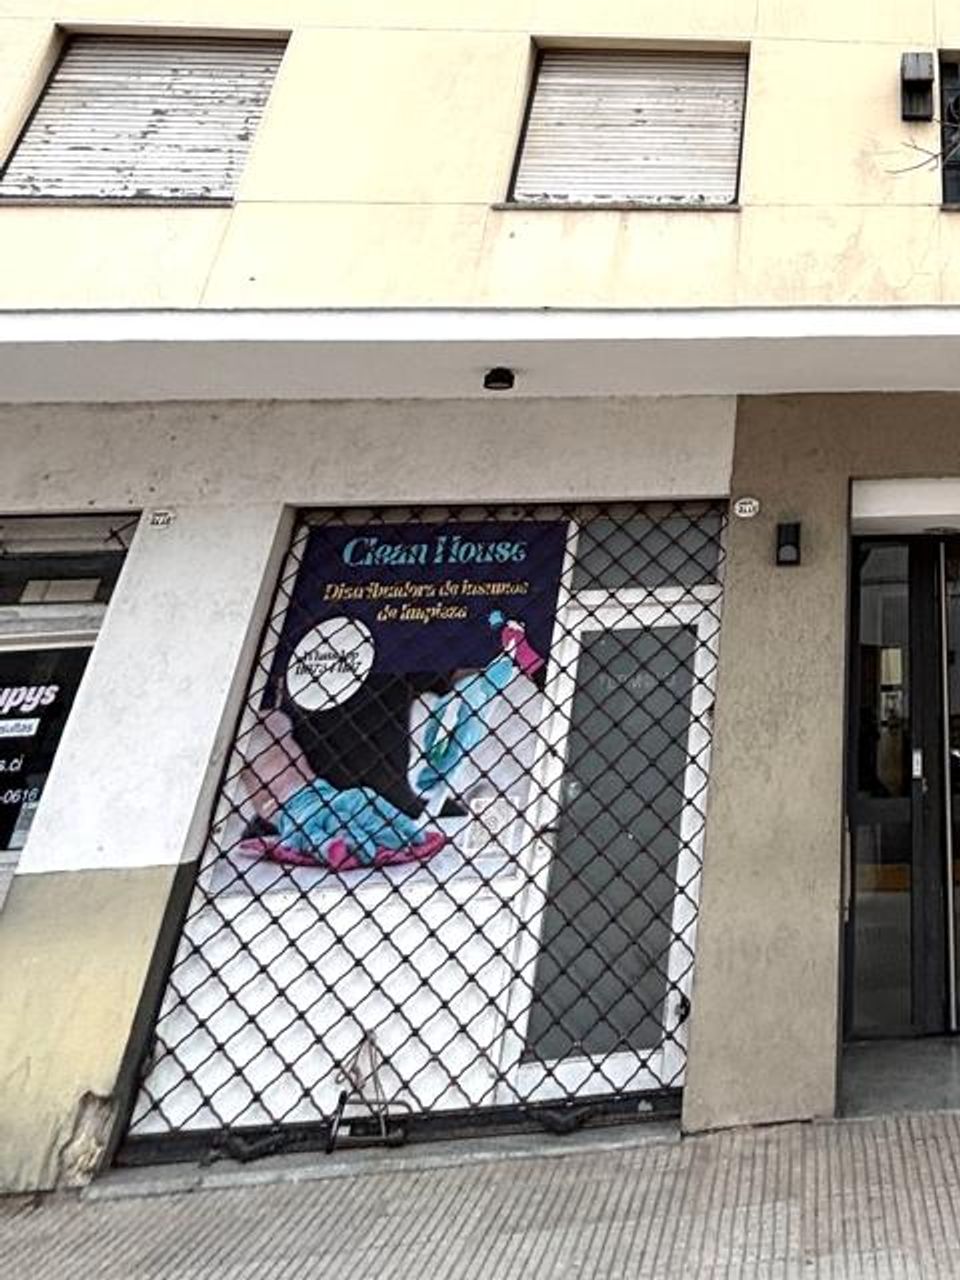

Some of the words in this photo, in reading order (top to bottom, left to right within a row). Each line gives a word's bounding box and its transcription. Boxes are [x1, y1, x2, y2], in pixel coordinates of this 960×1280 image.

[342, 536, 427, 567] Clean
[434, 535, 528, 564] House
[323, 582, 436, 601] Distribuidora
[438, 582, 459, 597] de
[460, 580, 530, 596] insumos
[376, 604, 399, 621] de
[400, 602, 468, 624] limpieza
